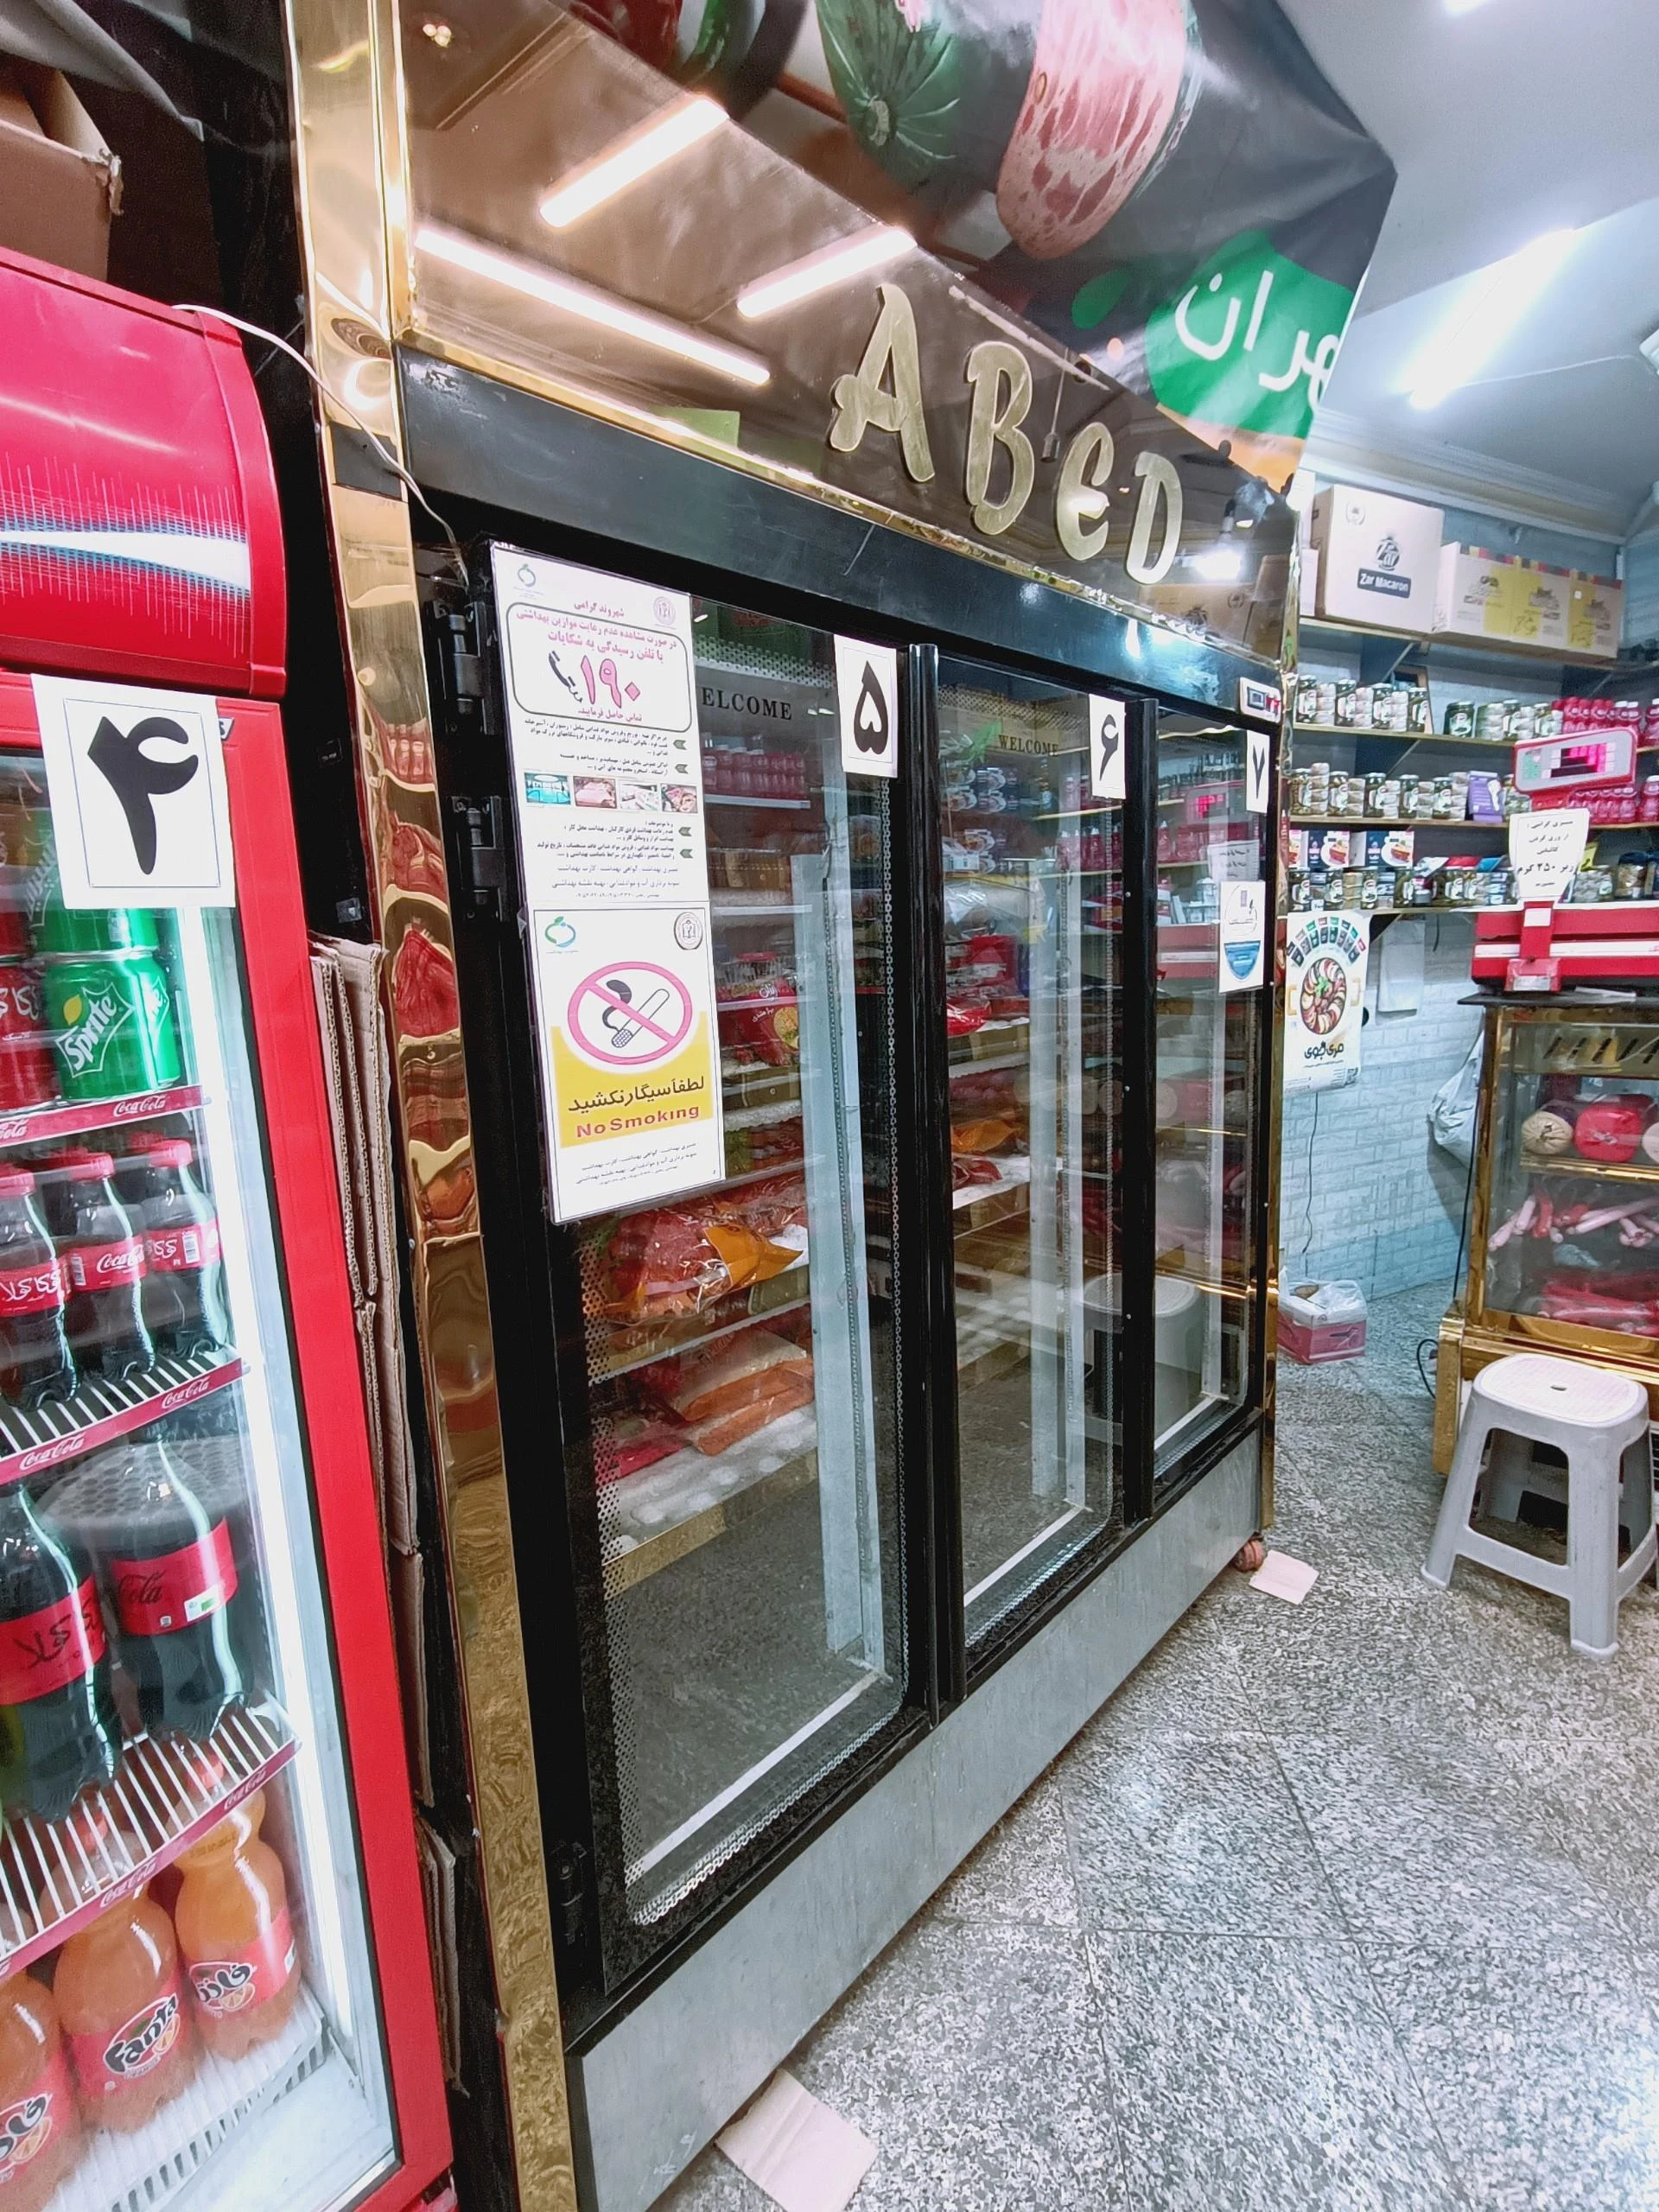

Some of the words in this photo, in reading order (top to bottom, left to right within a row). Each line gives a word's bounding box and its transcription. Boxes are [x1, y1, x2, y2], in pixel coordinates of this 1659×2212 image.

[1173, 270, 1339, 407] هران
[829, 283, 1184, 586] ABED
[1359, 573, 1375, 585] Zar
[1375, 576, 1409, 592] Macaron
[580, 654, 641, 709] ۱۹۰
[701, 686, 792, 721] ELCOME
[853, 660, 889, 756] ۵
[998, 734, 1058, 757] WELCOME
[1099, 713, 1121, 782] ۶
[1252, 743, 1266, 800] ۷
[86, 715, 200, 876] ۴
[64, 995, 118, 1071] Sprite
[567, 1089, 625, 1114] نکشید
[576, 1123, 606, 1138] No
[610, 1106, 699, 1131] Smoking
[624, 1083, 671, 1107] سیگار
[105, 1994, 177, 2074] Fanta
